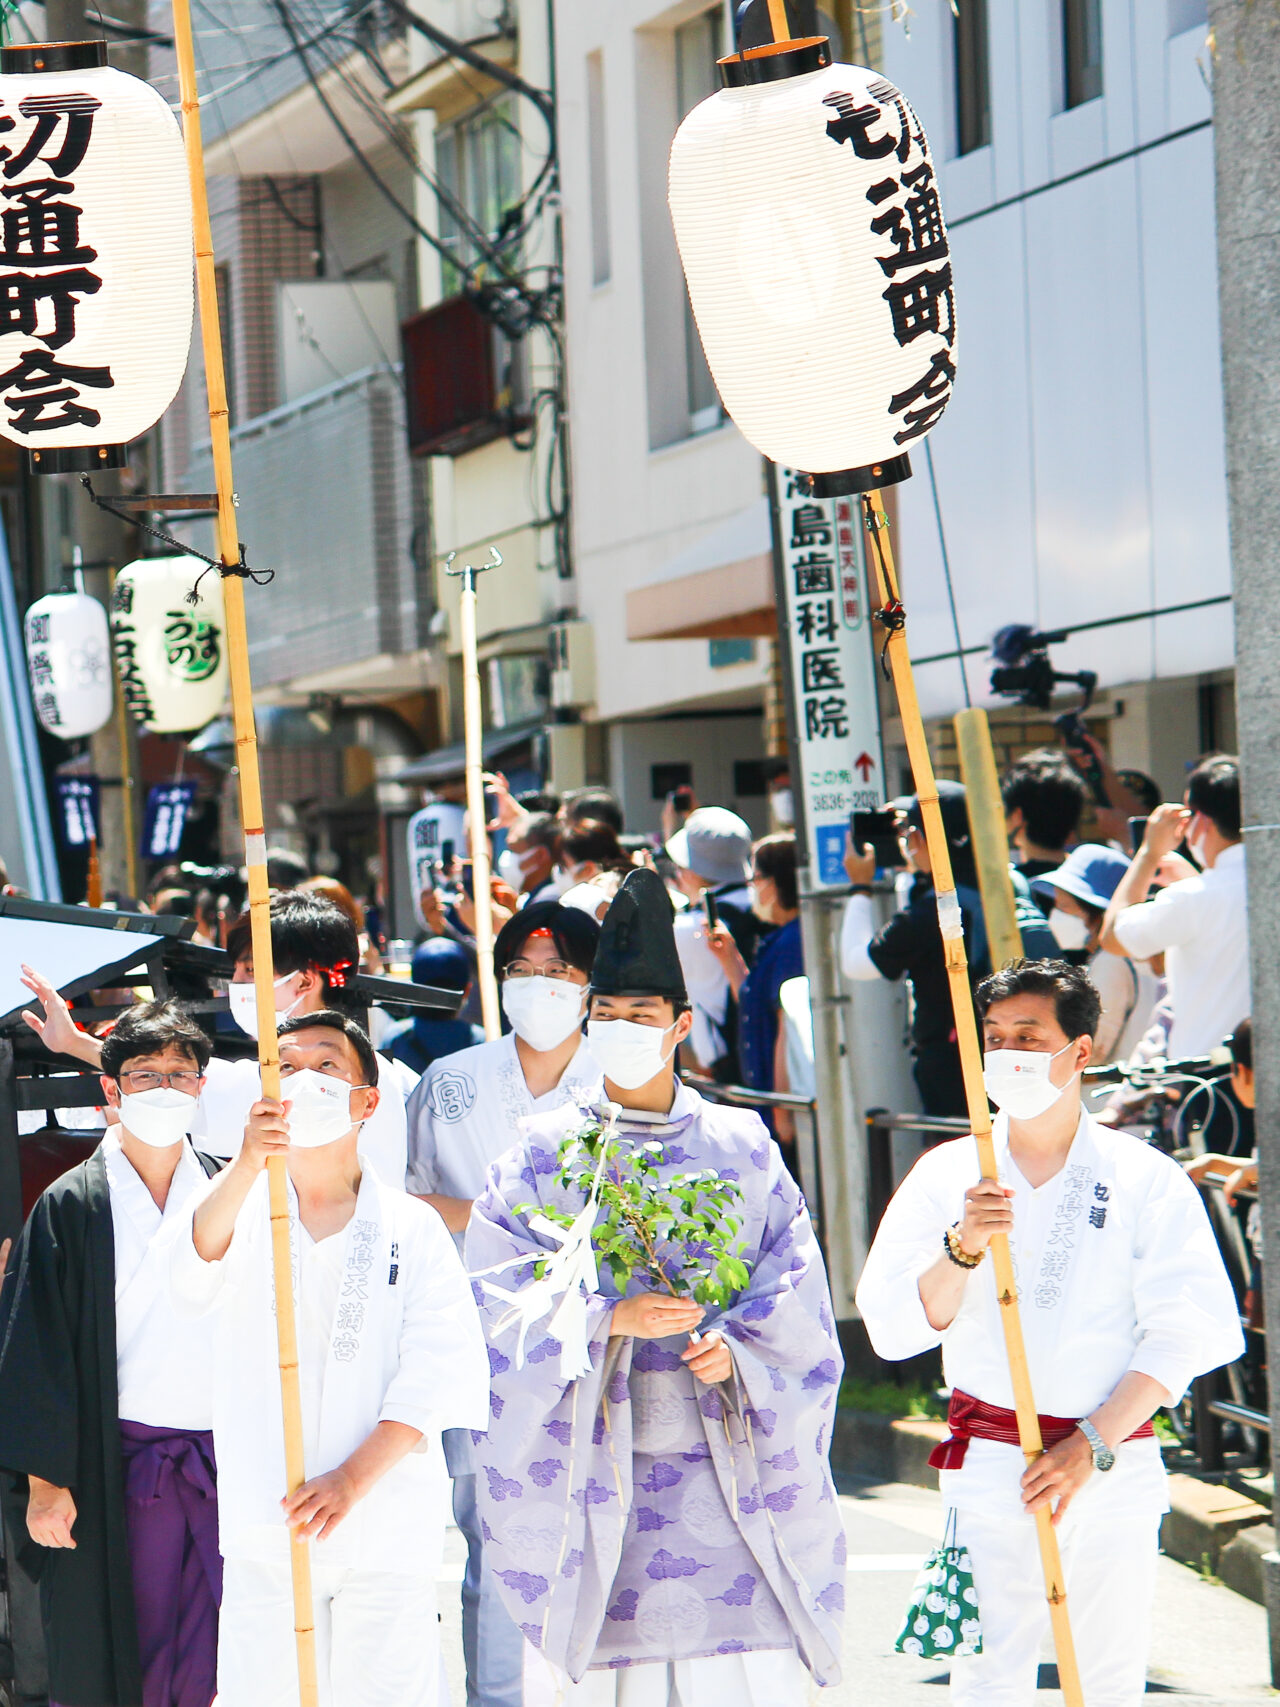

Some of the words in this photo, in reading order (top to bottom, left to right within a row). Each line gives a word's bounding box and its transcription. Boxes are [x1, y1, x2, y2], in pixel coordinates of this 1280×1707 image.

[332, 1219, 381, 1363] 湯島天満宮
[1033, 1163, 1094, 1310] 湯島天満宮
